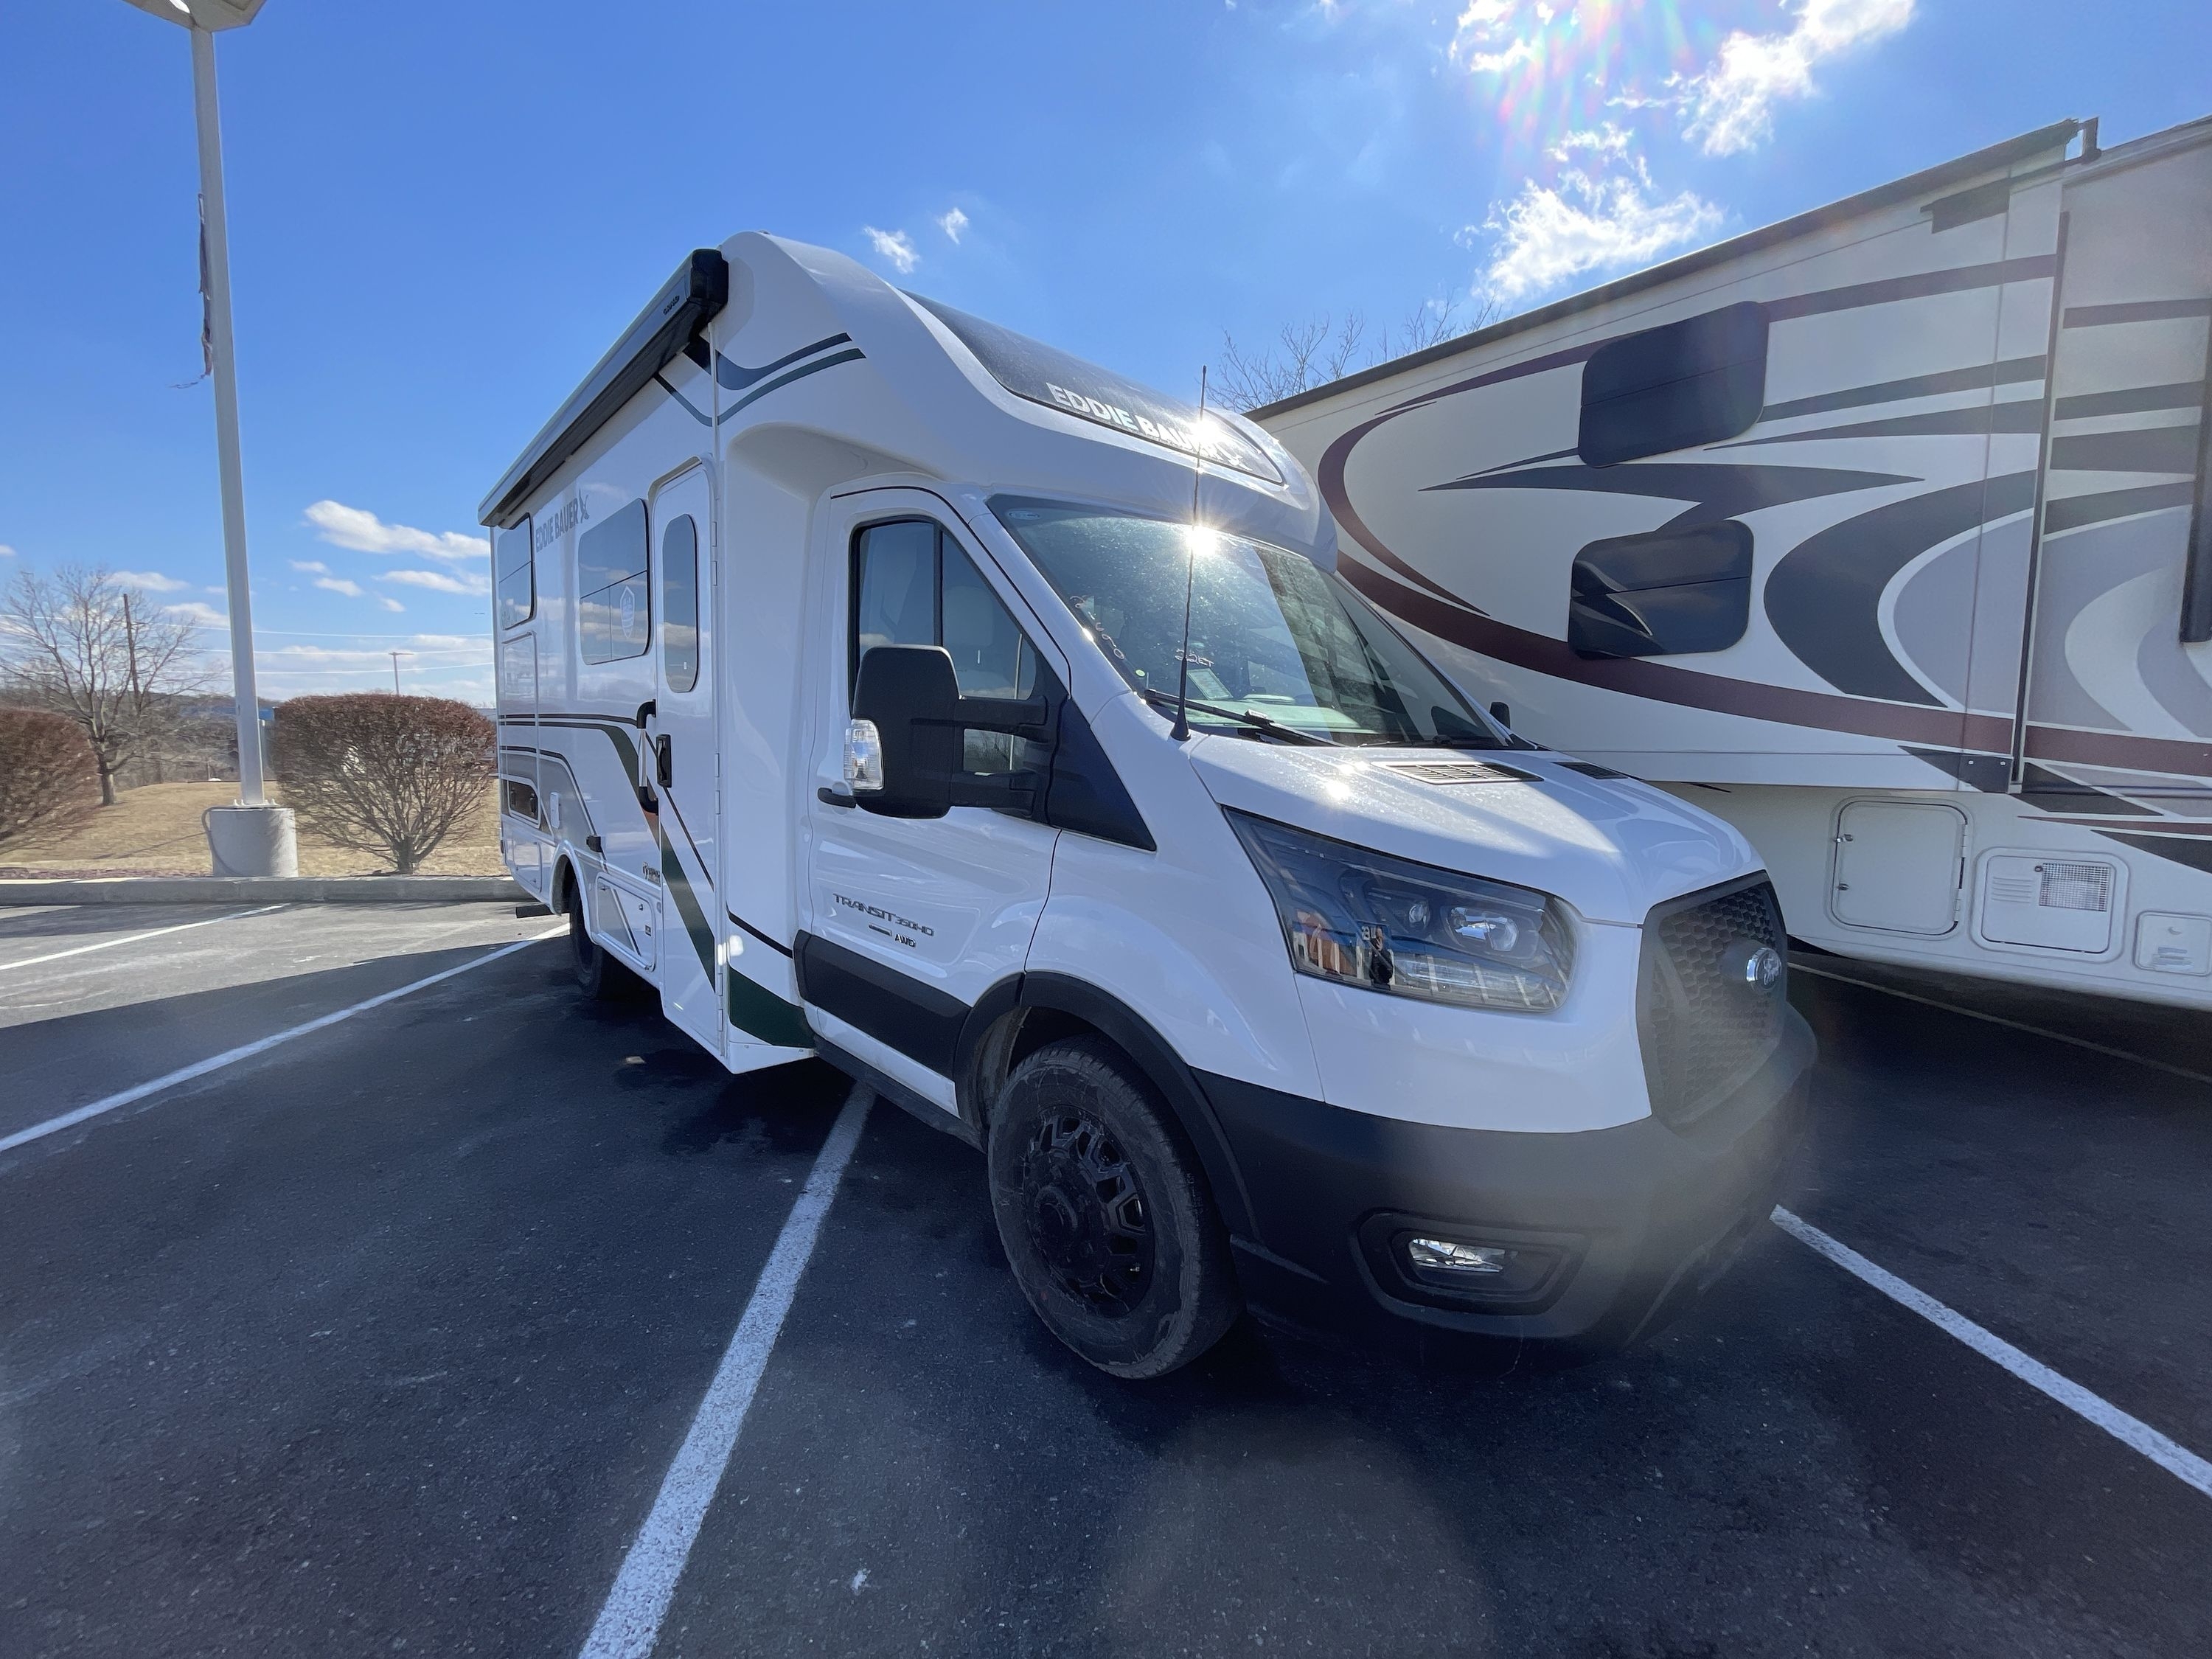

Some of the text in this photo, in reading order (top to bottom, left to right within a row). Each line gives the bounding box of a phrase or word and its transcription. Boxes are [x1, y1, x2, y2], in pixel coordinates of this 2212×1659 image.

[1046, 382, 1139, 431] EDDIE
[536, 498, 579, 553] EDDIE BAUER
[832, 893, 896, 922] TRANSIT
[894, 933, 917, 947] AWD
